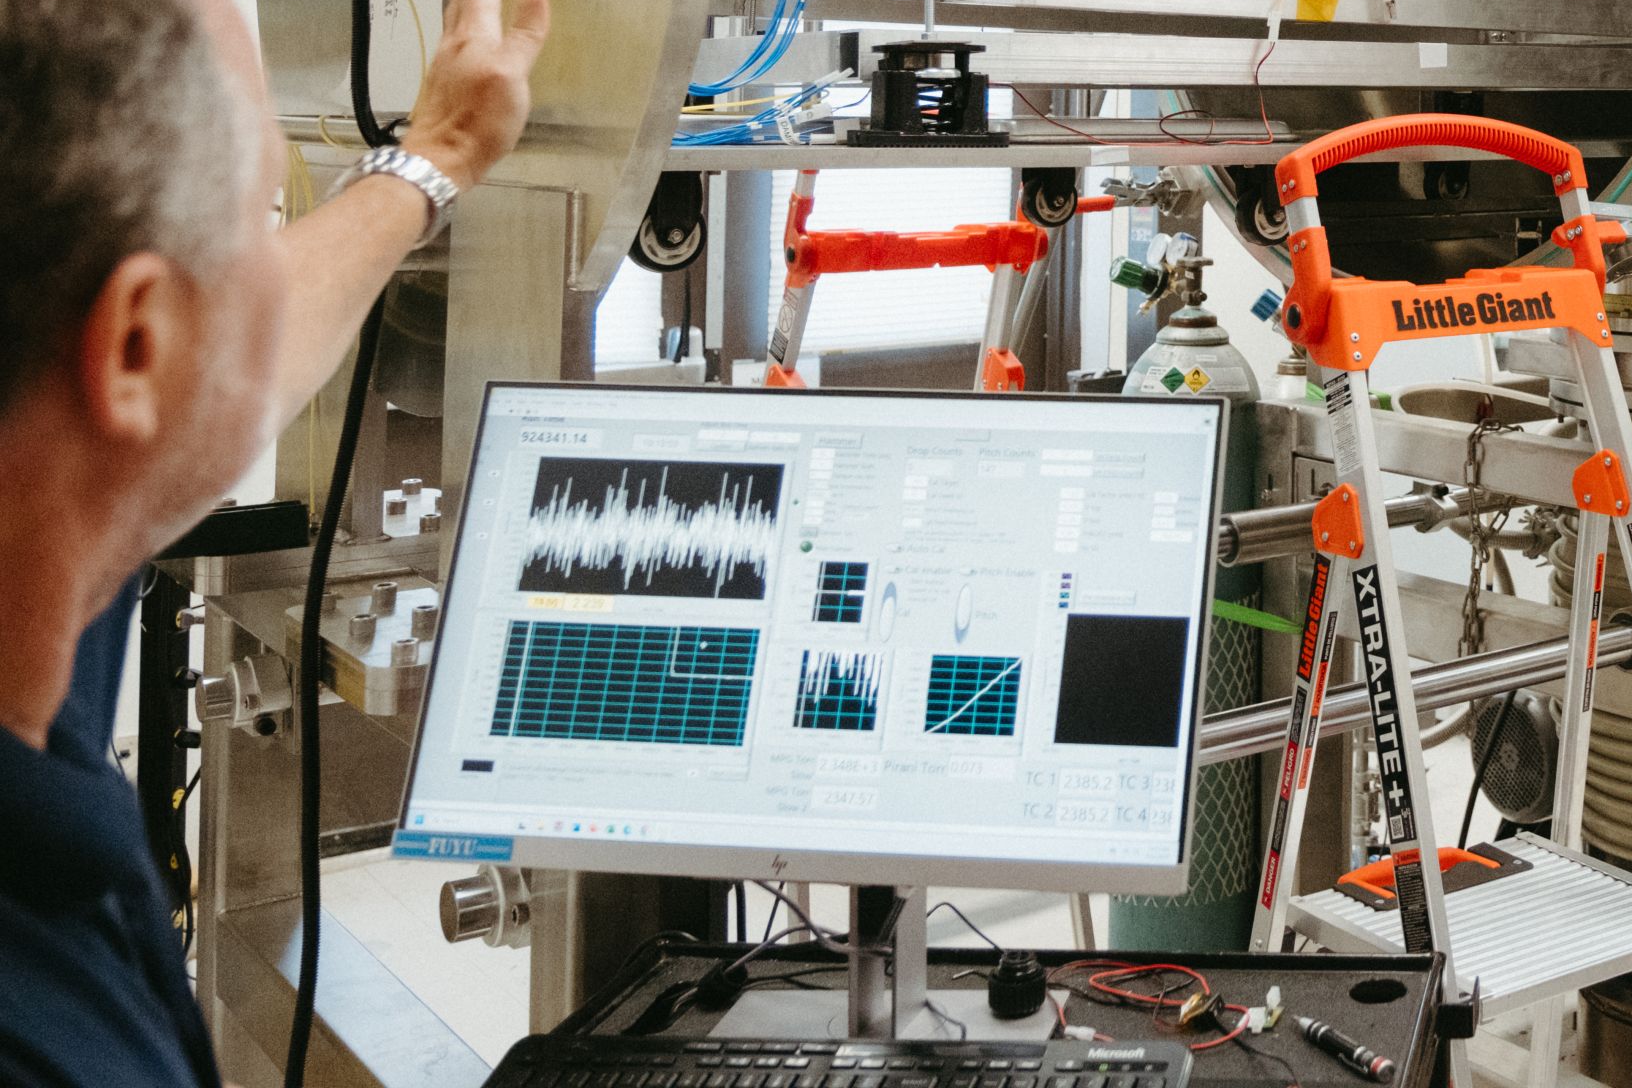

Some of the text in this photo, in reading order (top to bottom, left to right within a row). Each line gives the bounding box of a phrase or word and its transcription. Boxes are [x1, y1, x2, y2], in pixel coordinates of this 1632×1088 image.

[520, 430, 588, 445] 924341.14
[1284, 747, 1295, 788] PELIGRO
[1027, 771, 1043, 786] TC
[1063, 774, 1113, 791] 2385.2
[1118, 773, 1150, 791] TC 3
[1023, 802, 1040, 819] TC
[1116, 806, 1147, 822] TC 4
[428, 837, 479, 856] FUYU
[1265, 856, 1277, 895] DANGER
[1087, 1046, 1145, 1059] Microsoft
